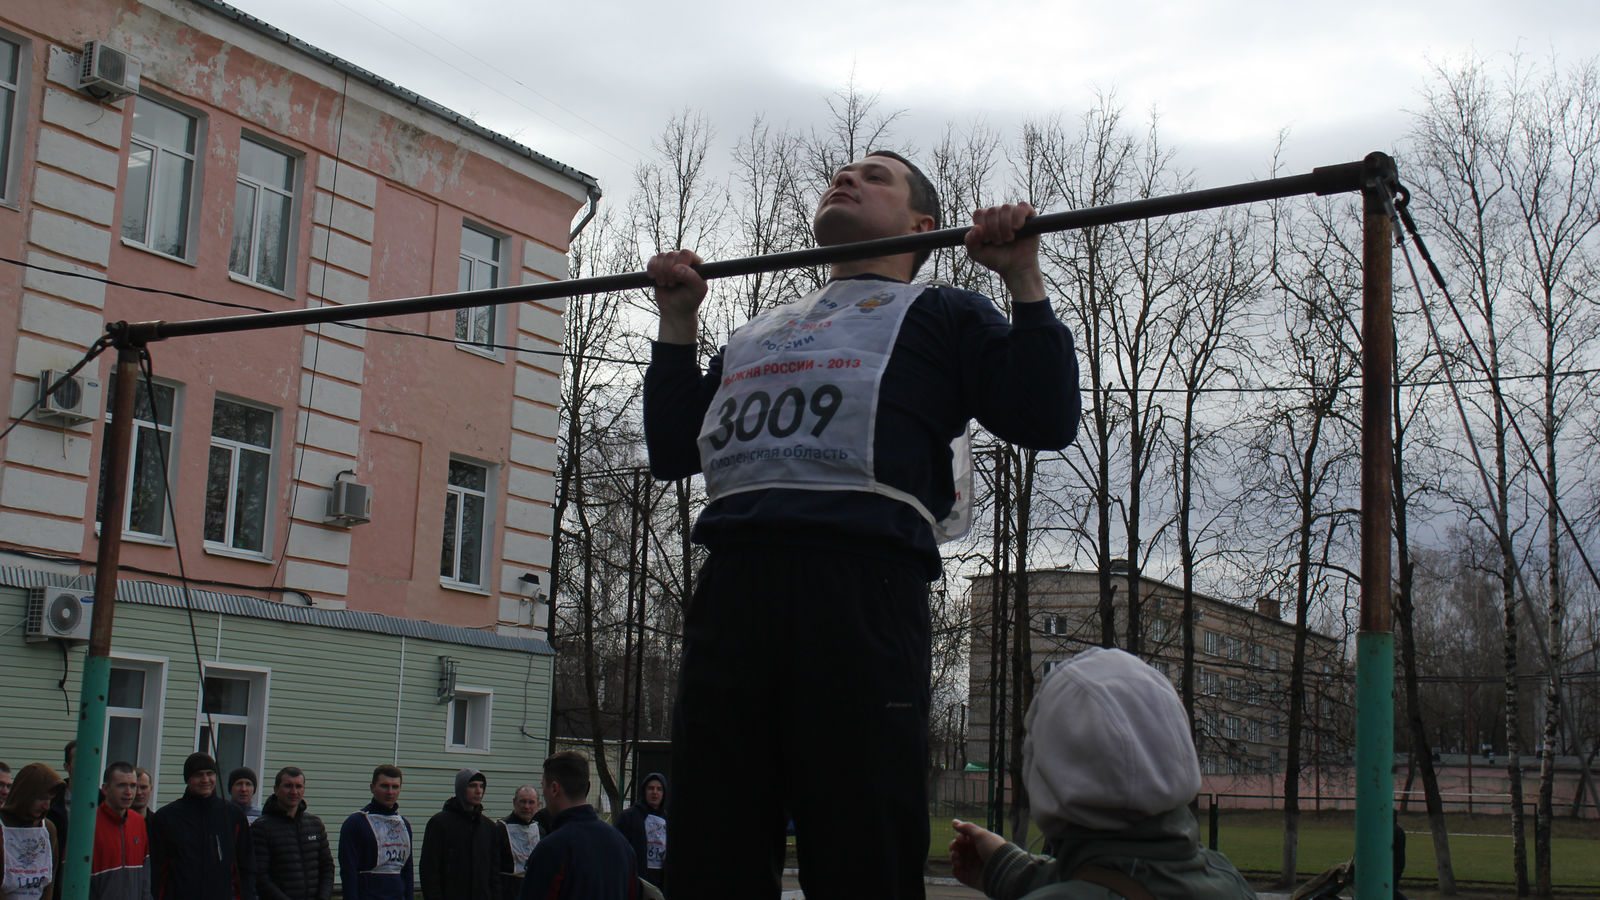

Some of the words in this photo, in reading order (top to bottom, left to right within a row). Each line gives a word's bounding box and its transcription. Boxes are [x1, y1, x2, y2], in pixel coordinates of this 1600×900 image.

[762, 335, 815, 352] РОССИИ
[763, 360, 815, 375] РОССИИ
[827, 358, 861, 370] 2013
[708, 384, 843, 451] 3009
[783, 444, 848, 460] область
